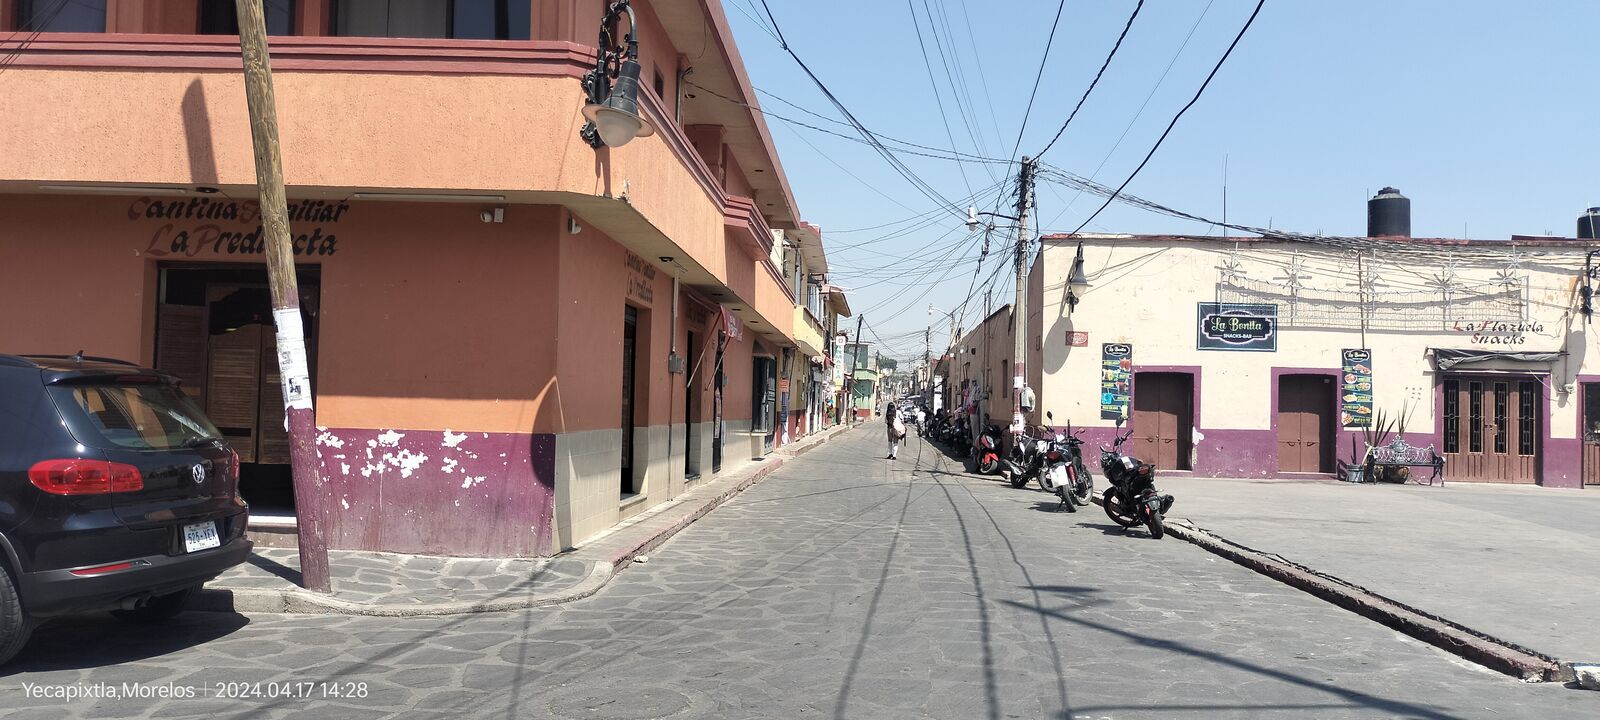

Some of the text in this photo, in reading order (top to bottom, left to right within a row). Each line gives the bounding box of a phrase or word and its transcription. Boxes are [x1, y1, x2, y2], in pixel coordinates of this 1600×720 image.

[127, 196, 239, 221] Cantina
[143, 223, 189, 257] La
[1210, 317, 1263, 332] La Bonita
[1453, 316, 1544, 333] La Plazuela
[1470, 333, 1526, 345] Snacks
